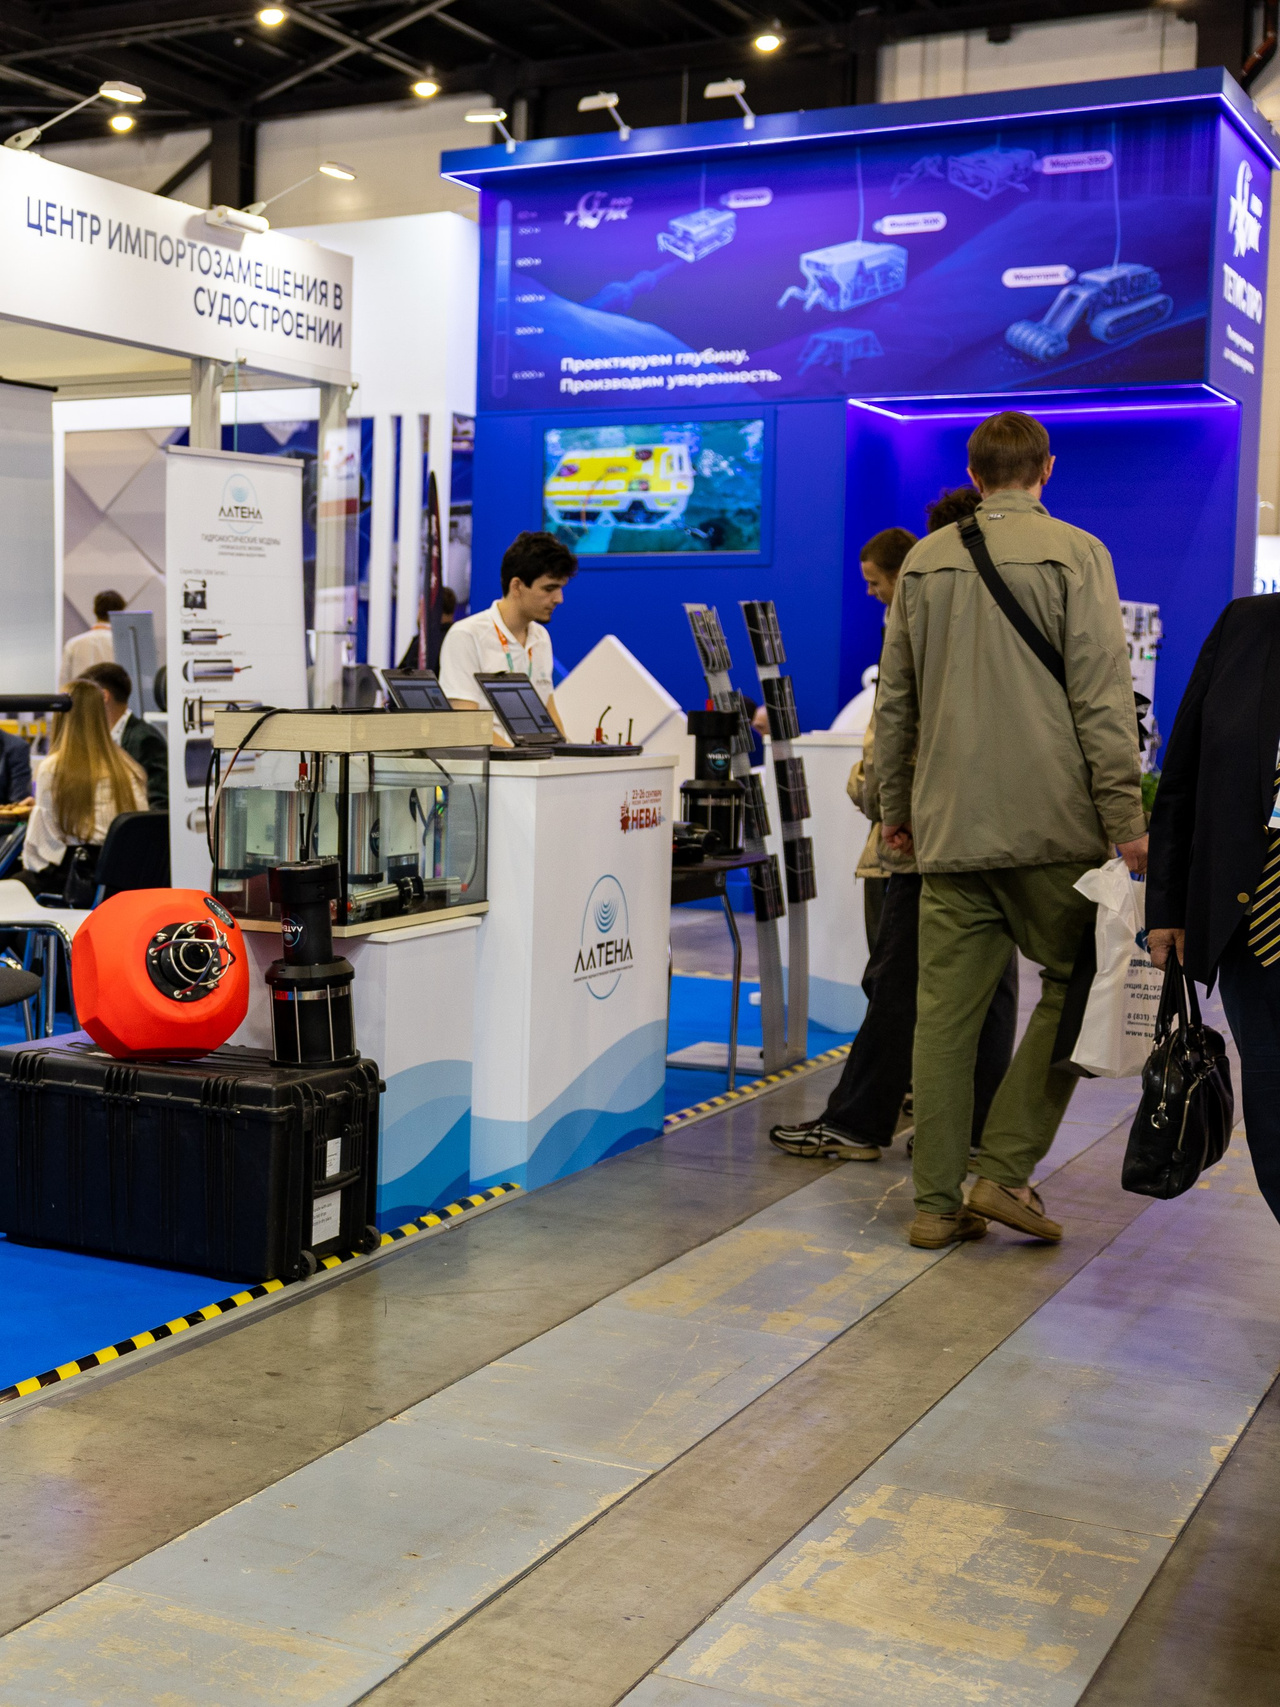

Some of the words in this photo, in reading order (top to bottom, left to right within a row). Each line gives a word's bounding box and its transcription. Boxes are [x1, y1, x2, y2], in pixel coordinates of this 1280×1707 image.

[26, 196, 101, 245] ЦЕНТР
[108, 218, 329, 308] ИМПОРТОЗАМЕЩЕНИЯ
[333, 282, 344, 311] В
[194, 286, 344, 349] СУДОСТРОЕНИИ
[561, 354, 673, 375] Проектируем
[674, 347, 750, 368] глубину.
[559, 375, 665, 396] Производим
[666, 369, 782, 391] уверенность.
[631, 807, 658, 830] НЕВА
